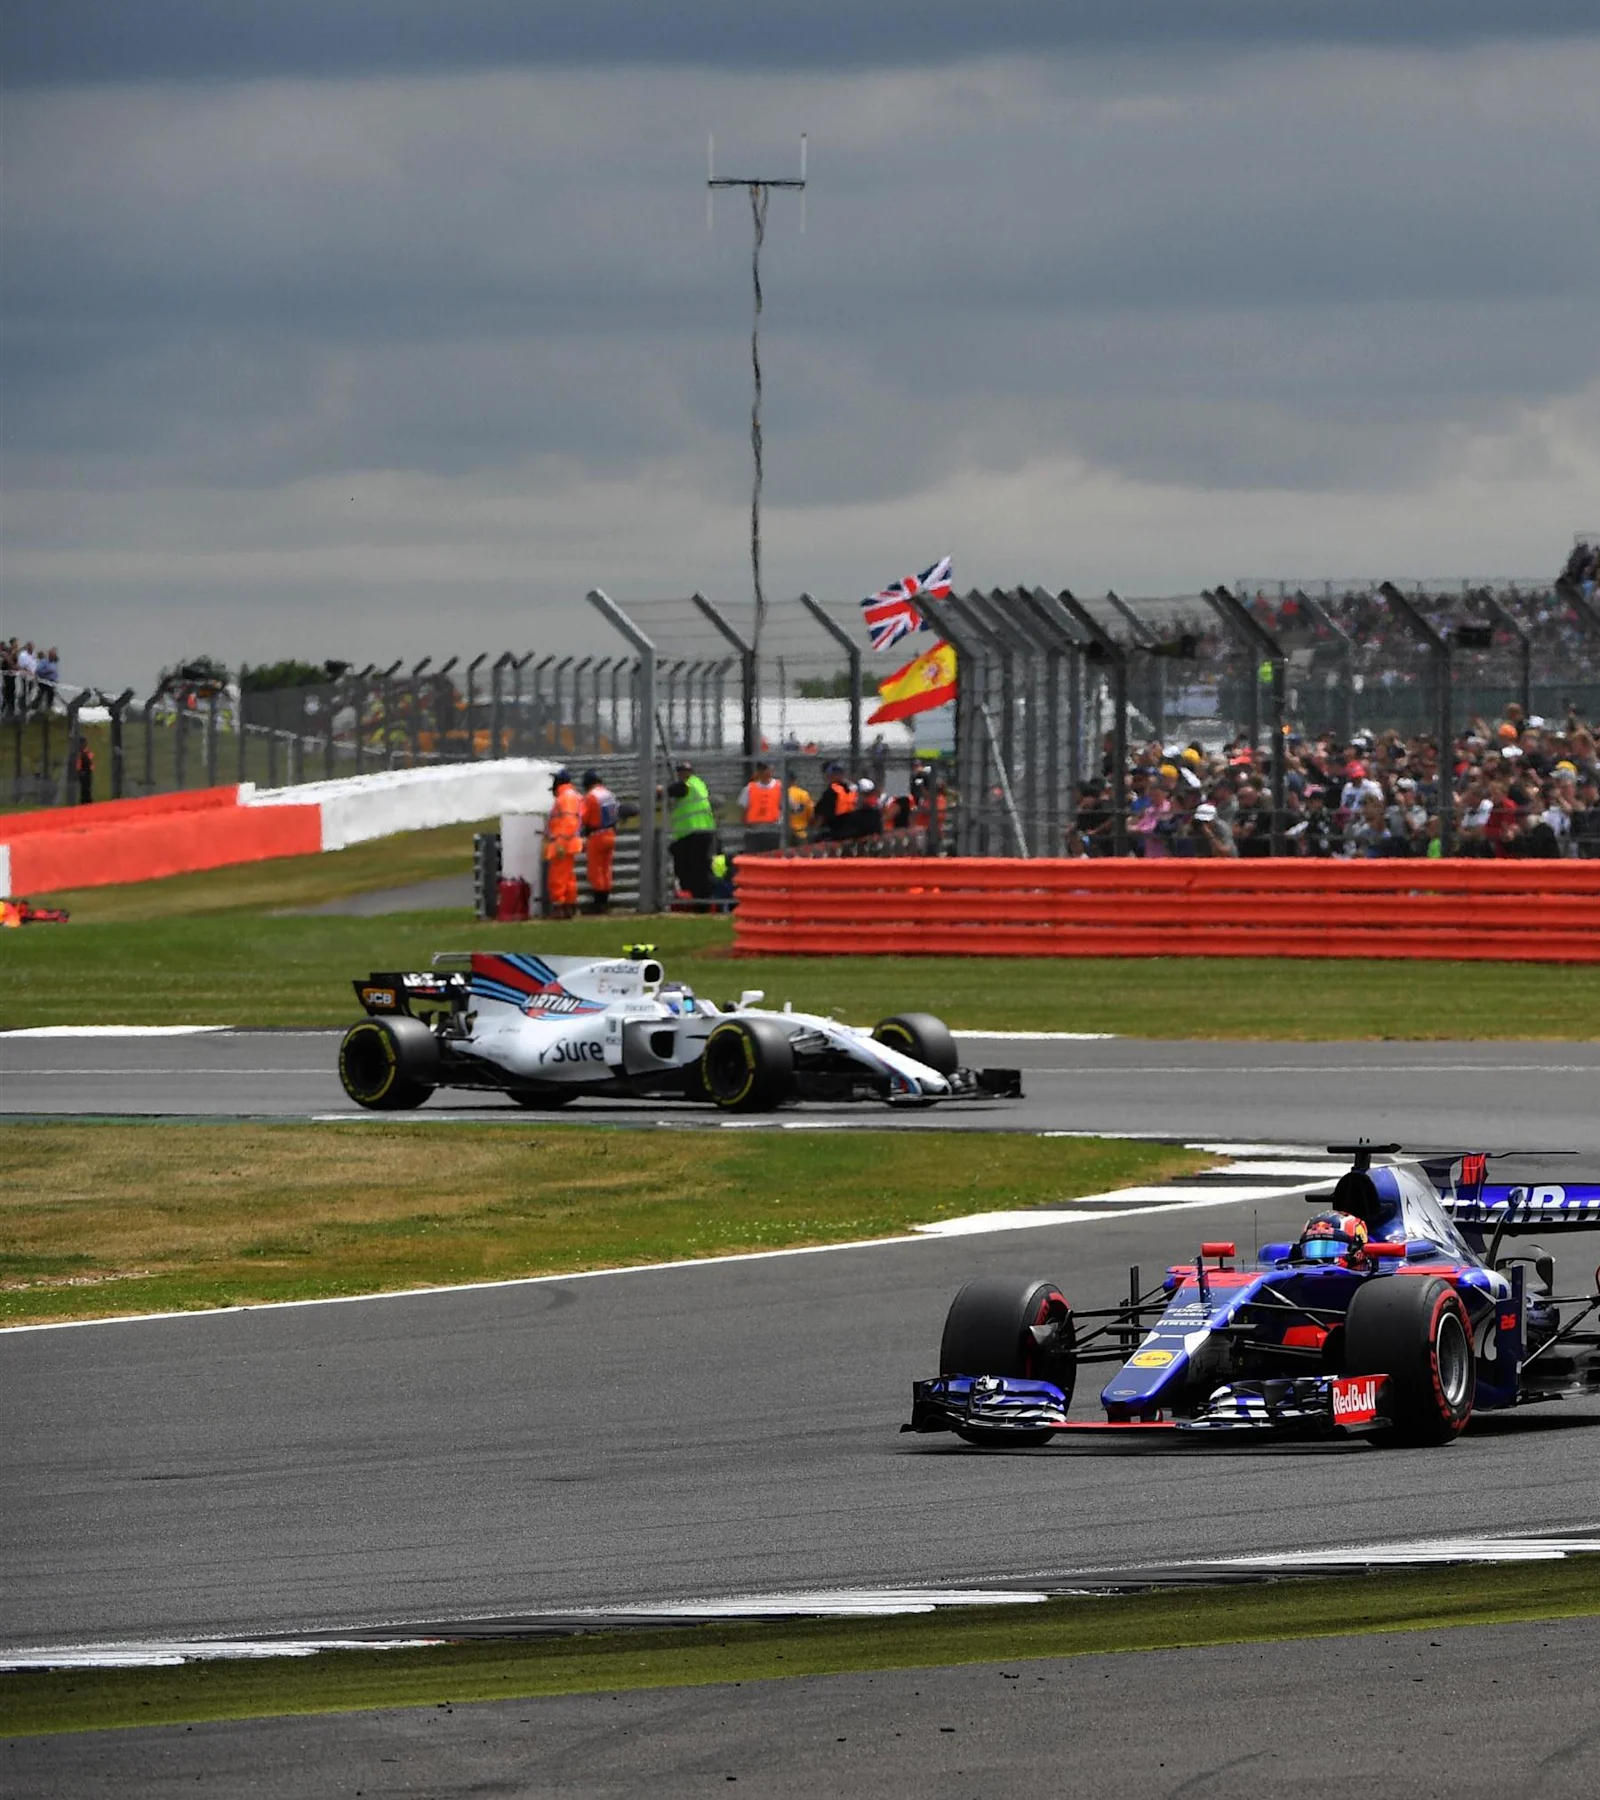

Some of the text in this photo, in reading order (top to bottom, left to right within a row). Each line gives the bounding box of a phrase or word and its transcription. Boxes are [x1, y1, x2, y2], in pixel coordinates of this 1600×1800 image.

[366, 992, 392, 1005] JCB
[552, 1037, 604, 1063] Sure
[1500, 1313, 1516, 1330] 26
[1333, 1381, 1376, 1415] RedBull
